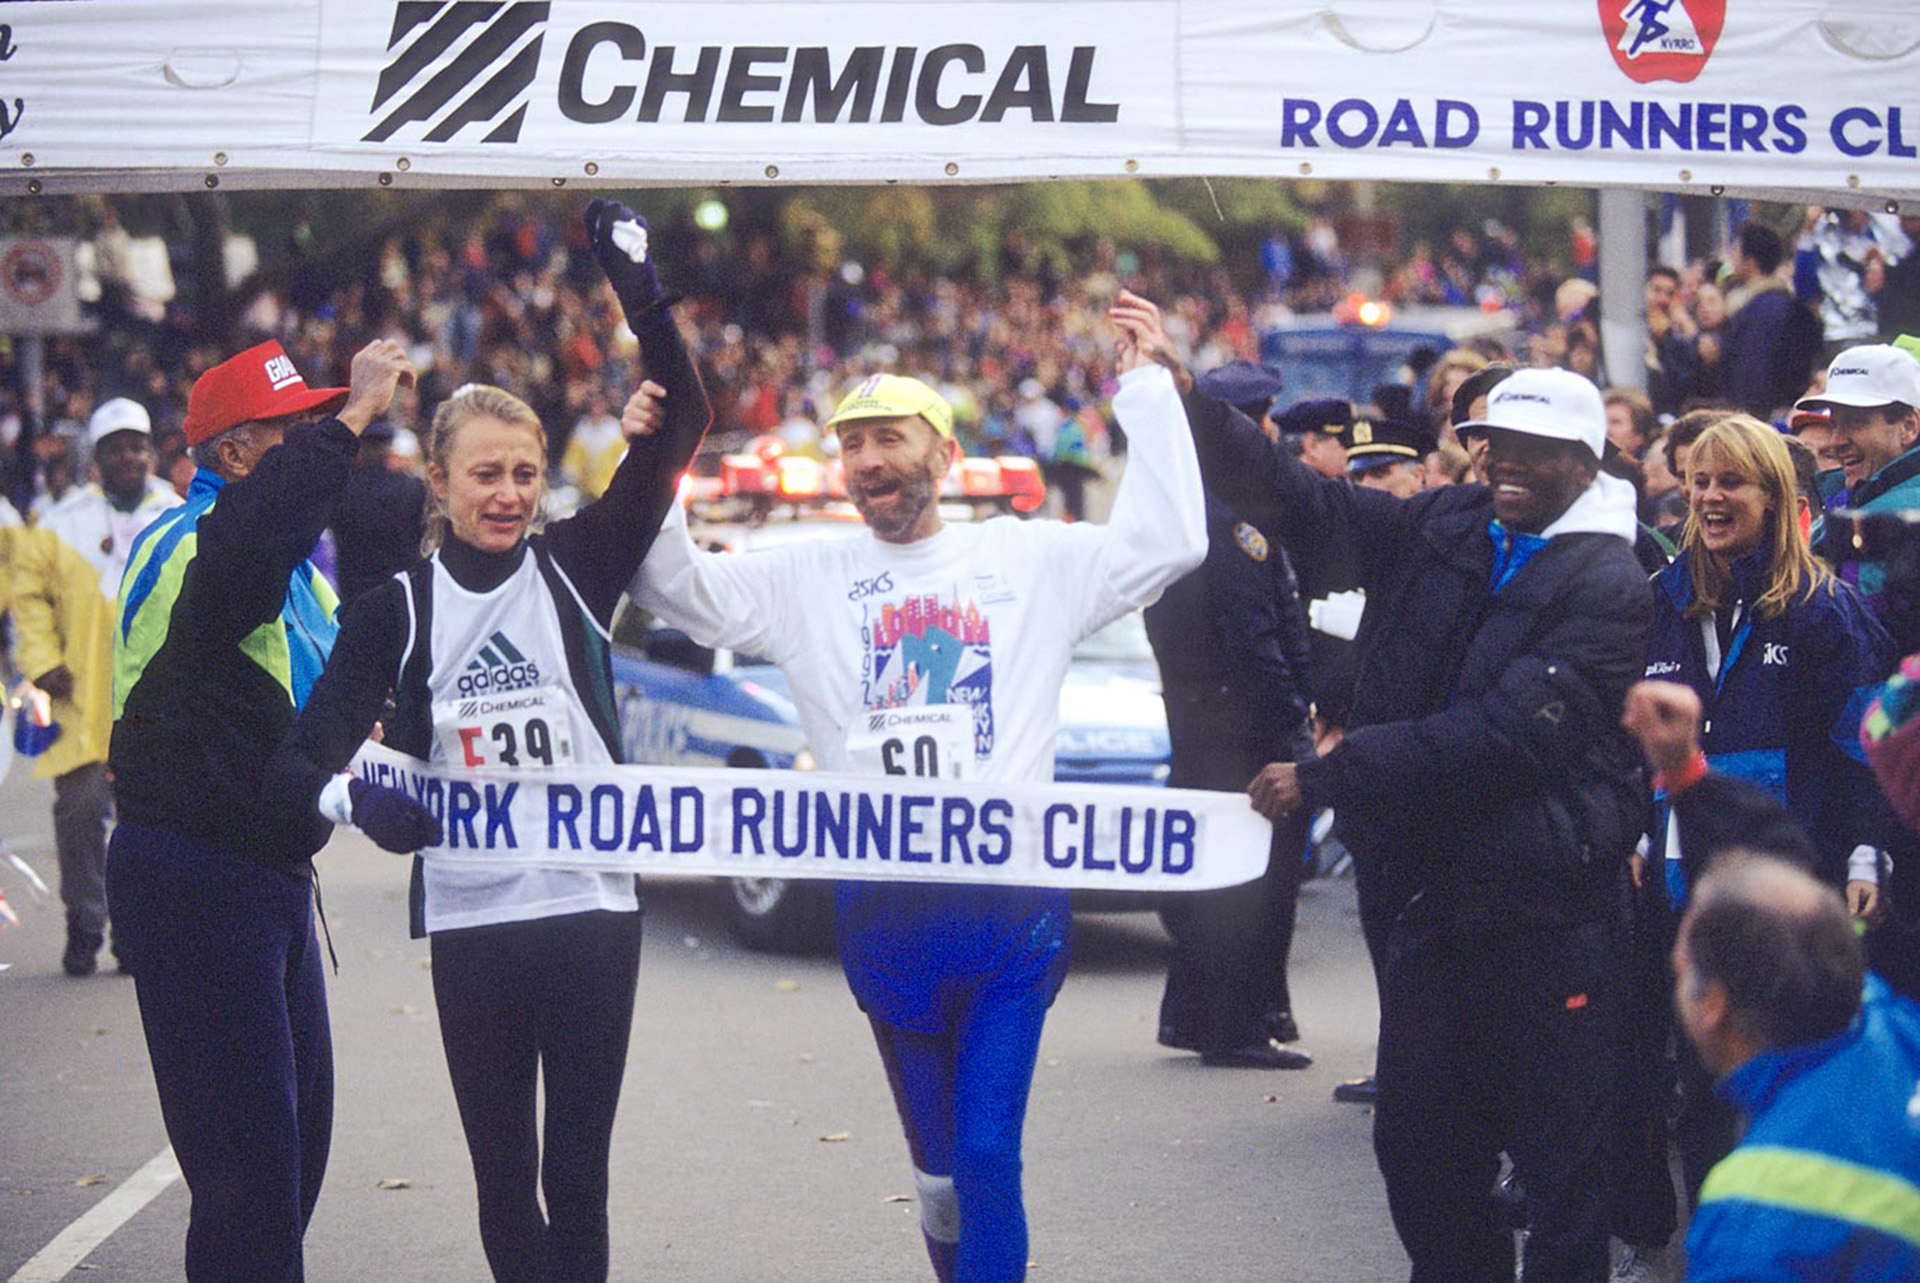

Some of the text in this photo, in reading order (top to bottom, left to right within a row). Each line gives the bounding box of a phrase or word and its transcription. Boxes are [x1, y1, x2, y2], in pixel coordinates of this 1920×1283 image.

[557, 21, 1118, 125] CHEMICAL
[1282, 99, 1917, 158] ROAD RUNNERS CL
[457, 663, 539, 693] adidas
[480, 697, 545, 714] CHEMICAL
[888, 713, 952, 727] CHEMICAL
[547, 783, 704, 853] ROAD
[732, 787, 1013, 865] RUNNERS
[1044, 803, 1196, 874] CLUB
